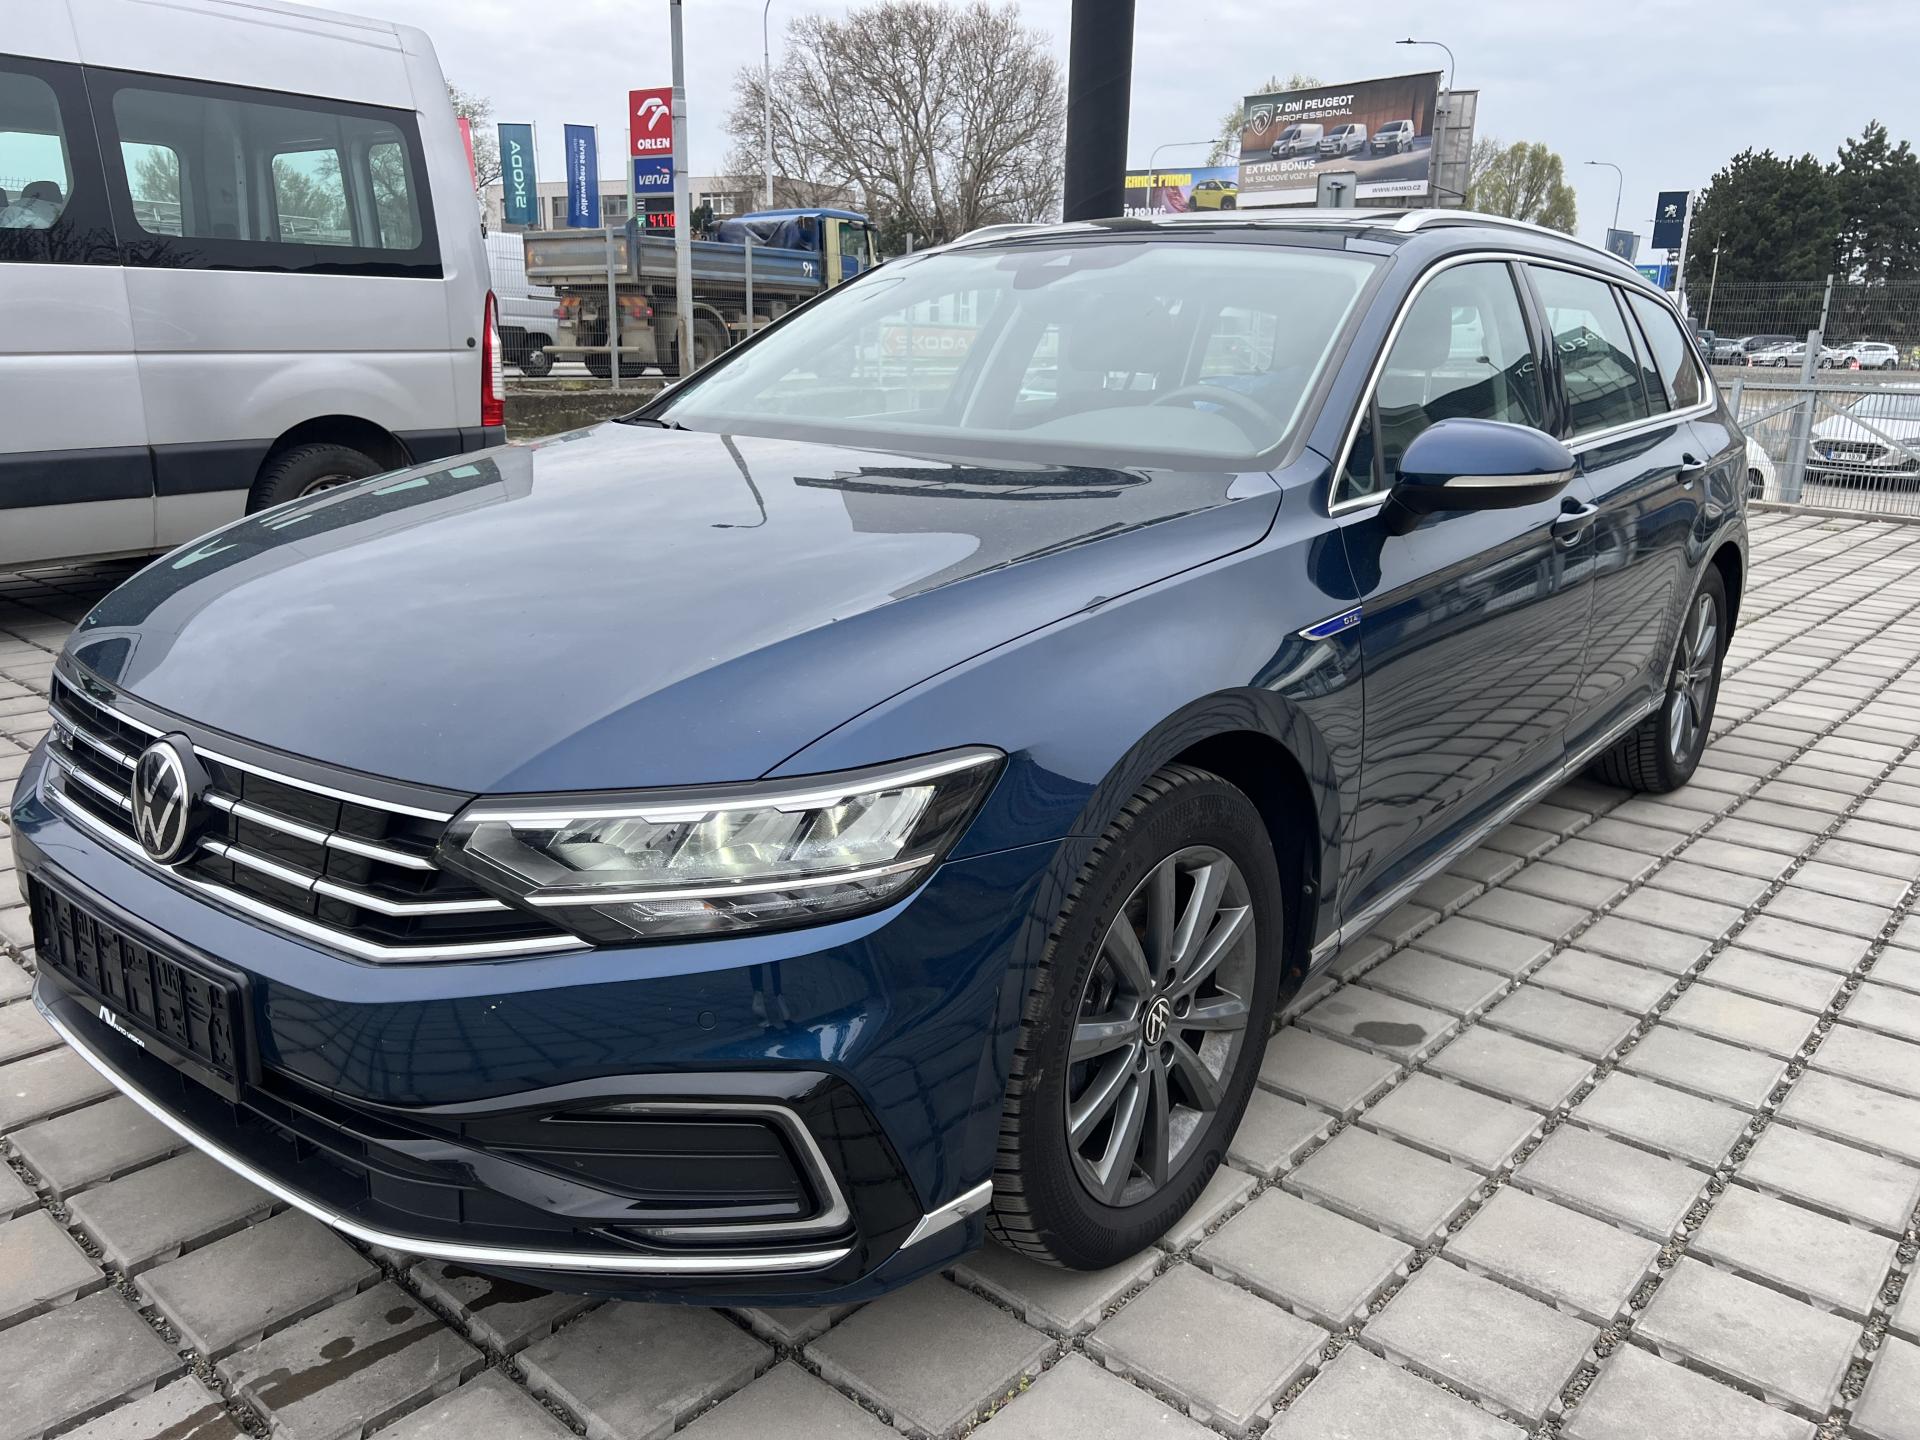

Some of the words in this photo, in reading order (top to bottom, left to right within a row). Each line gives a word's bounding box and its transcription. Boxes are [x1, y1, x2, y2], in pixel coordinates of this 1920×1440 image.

[1277, 104, 1284, 113] 7
[1285, 99, 1303, 112] DNÍ
[1305, 95, 1354, 109] PEUGEOT
[1276, 108, 1352, 122] PROFESSIONAL
[637, 138, 670, 149] ORLEN
[1246, 163, 1278, 175] EXTRA
[1281, 160, 1316, 172] BONUS
[638, 174, 670, 185] verva
